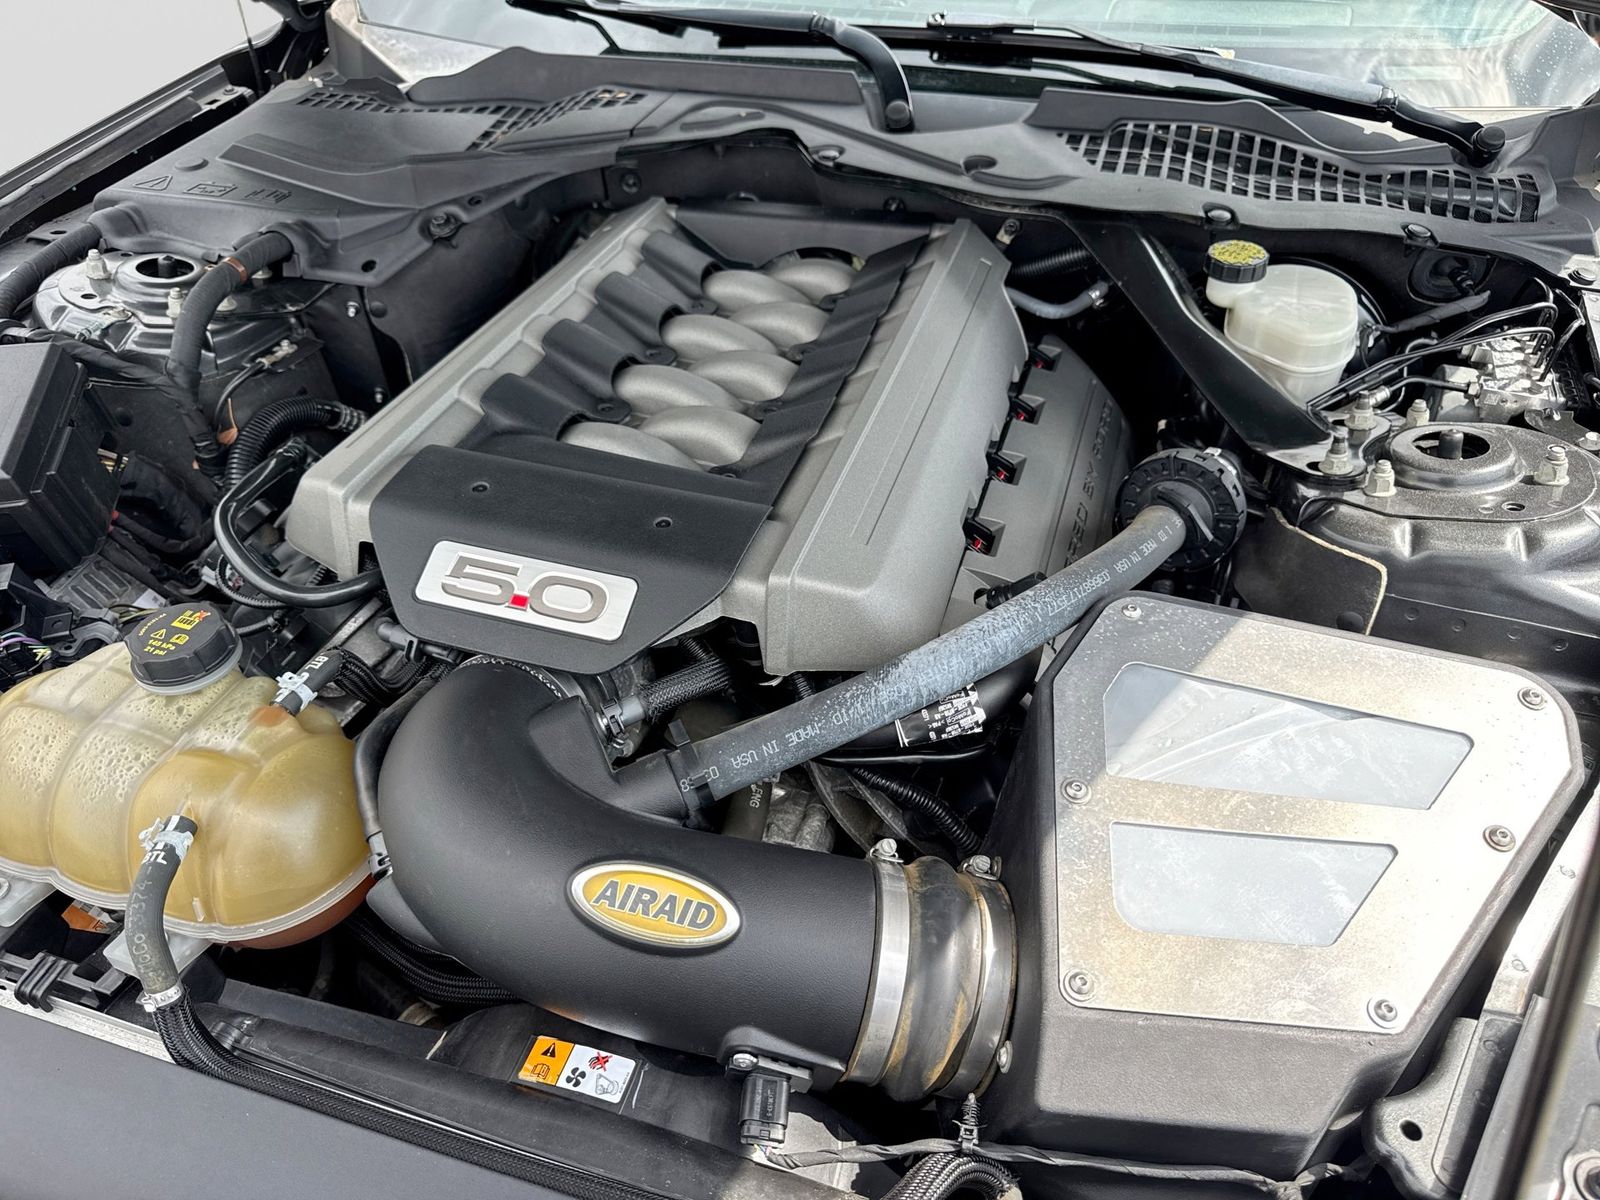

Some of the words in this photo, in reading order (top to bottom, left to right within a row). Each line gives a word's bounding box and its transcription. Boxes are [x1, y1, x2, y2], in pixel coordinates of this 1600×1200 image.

[1129, 551, 1142, 564] IN
[1139, 539, 1158, 557] MADE
[1113, 558, 1132, 573] USA
[441, 552, 608, 624] 5.0
[786, 724, 820, 747] MADE
[762, 739, 780, 756] IN
[732, 749, 758, 769] USA
[591, 879, 717, 931] AIRAID
